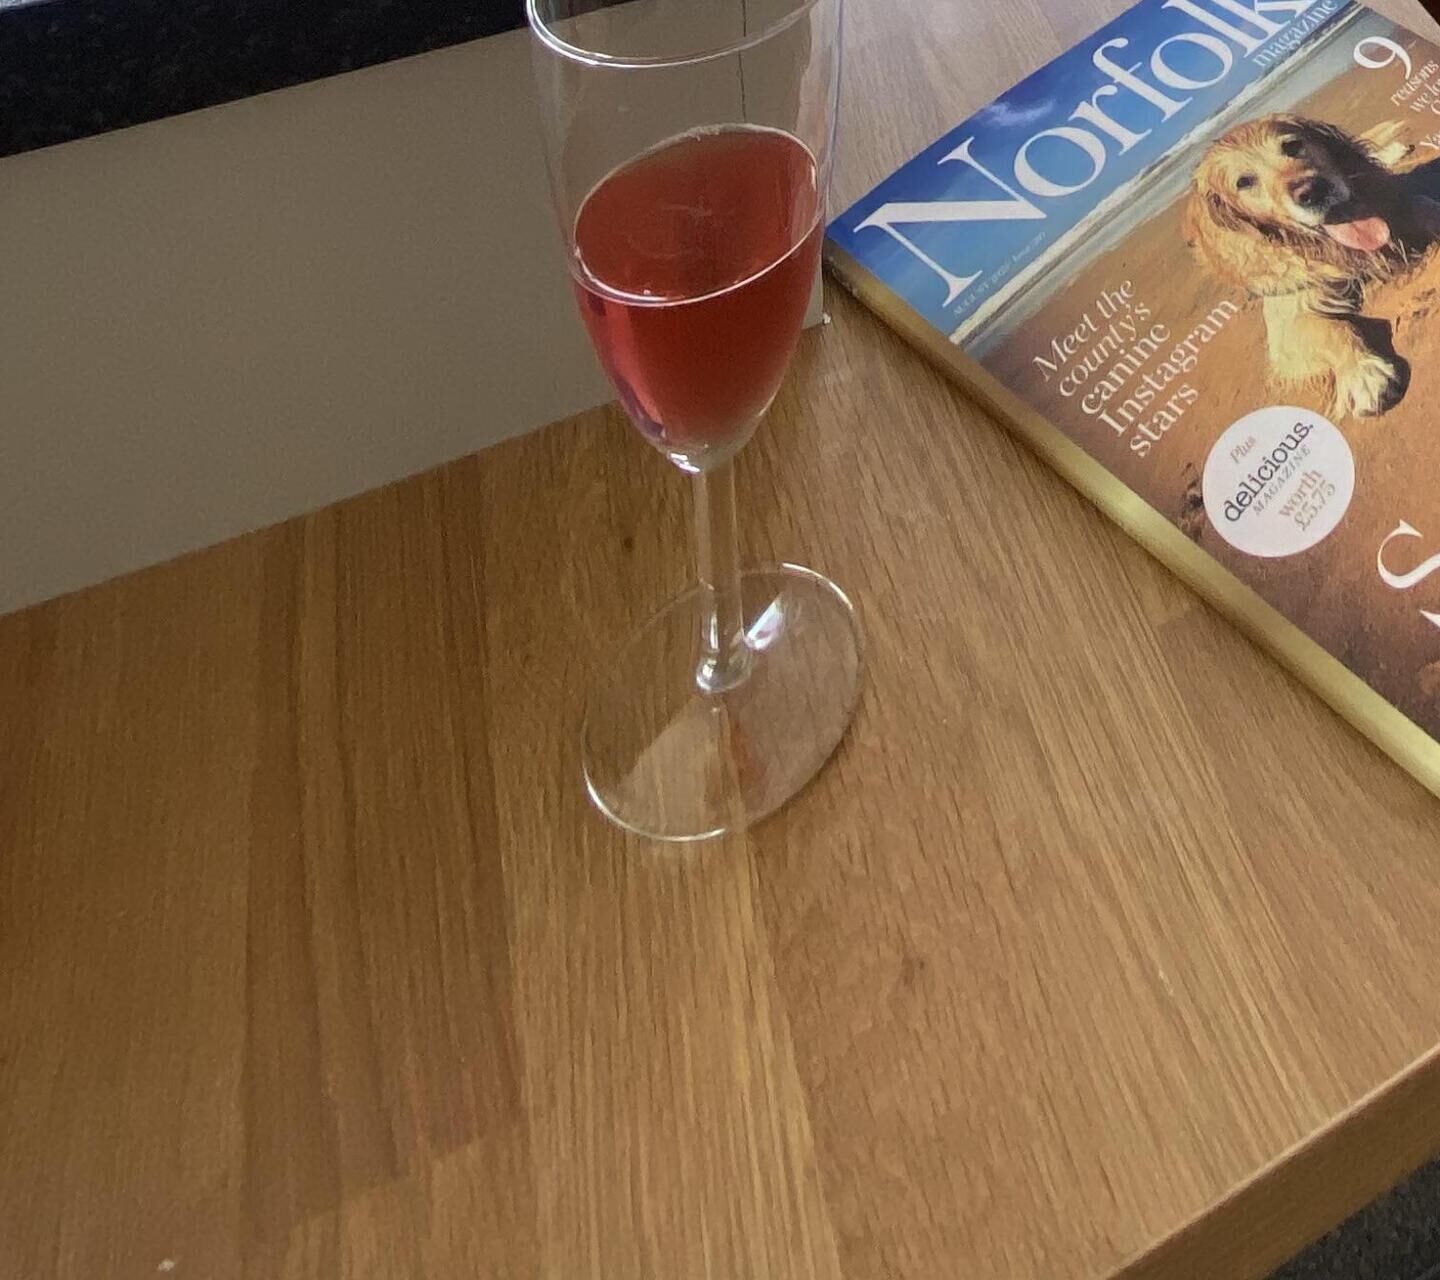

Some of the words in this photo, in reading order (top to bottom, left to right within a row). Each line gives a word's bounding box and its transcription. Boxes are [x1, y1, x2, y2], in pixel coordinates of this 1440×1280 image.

[1352, 35, 1412, 80] 9
[1391, 59, 1440, 107] reasons
[1409, 89, 1432, 113] we
[1032, 313, 1098, 382] Meet
[1096, 280, 1136, 319] the
[1059, 302, 1151, 397] county's
[1081, 323, 1171, 415] canine
[1097, 299, 1241, 437] Instagram
[1130, 384, 1199, 458] stars
[1230, 435, 1257, 464] Plus
[1224, 422, 1314, 523] delicious.
[1252, 444, 1312, 516] MAGAZINE
[1279, 469, 1323, 518] worth
[1294, 479, 1336, 532] £5.75
